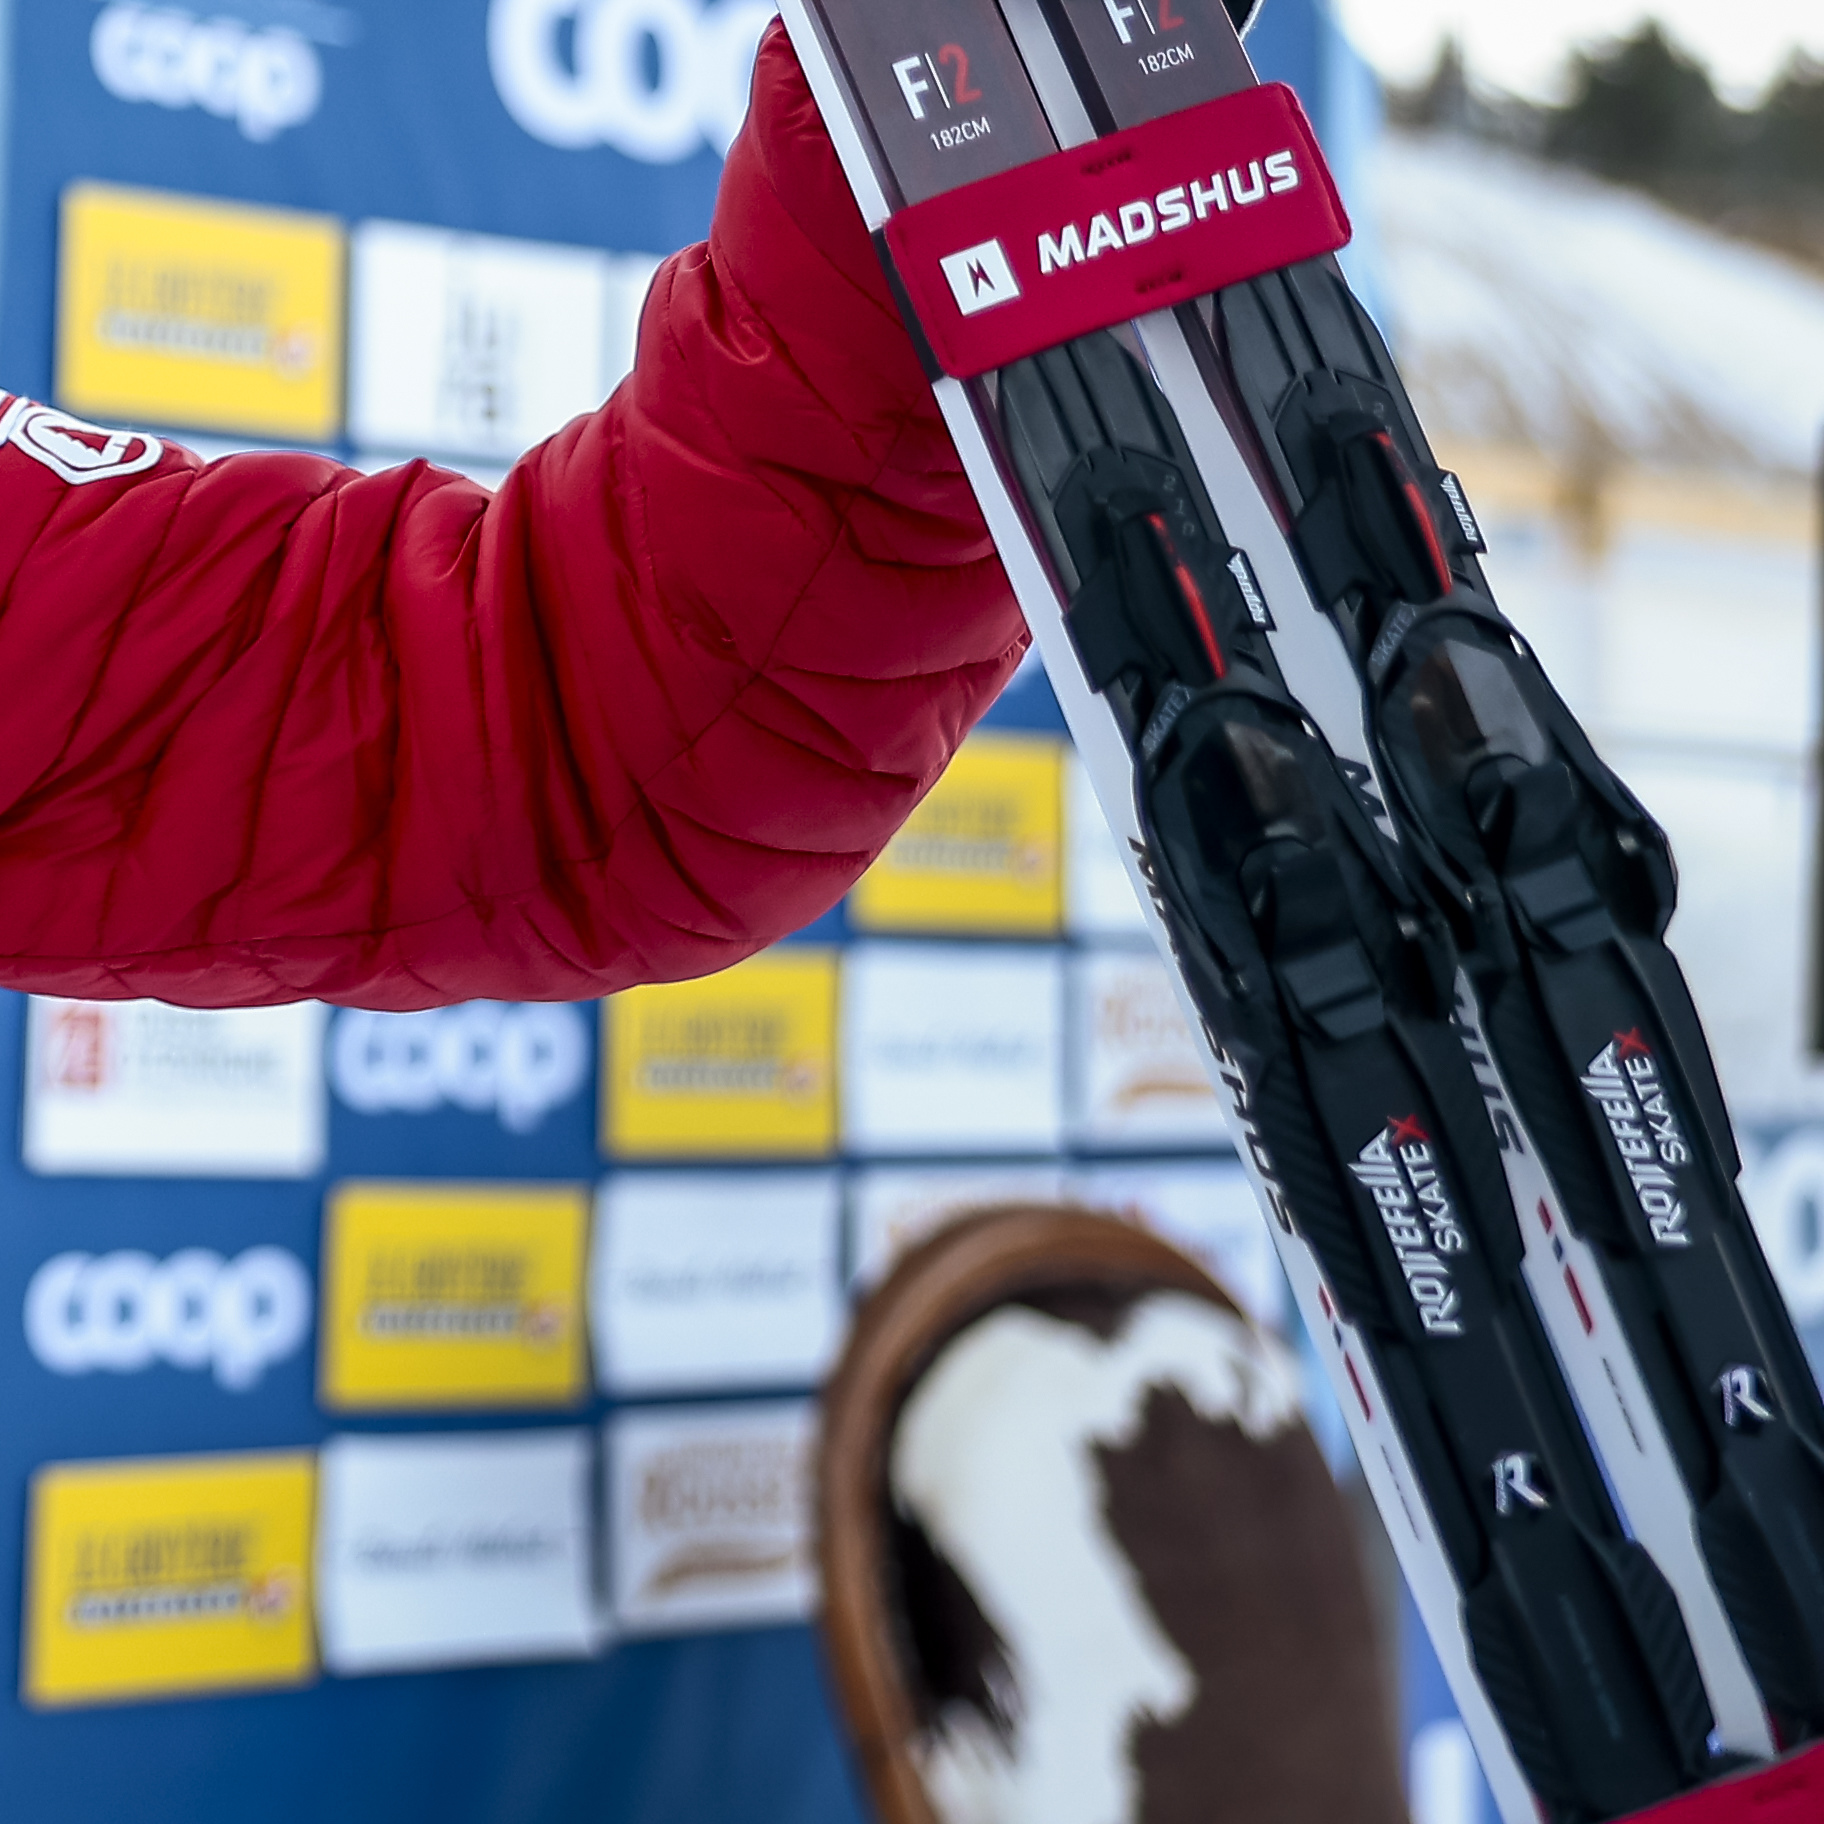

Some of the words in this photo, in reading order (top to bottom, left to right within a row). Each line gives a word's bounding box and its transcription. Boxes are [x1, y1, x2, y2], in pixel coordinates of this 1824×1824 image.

[1137, 42, 1196, 77] 182CM
[930, 114, 992, 152] 182CM
[1036, 150, 1299, 275] MADSHUS
